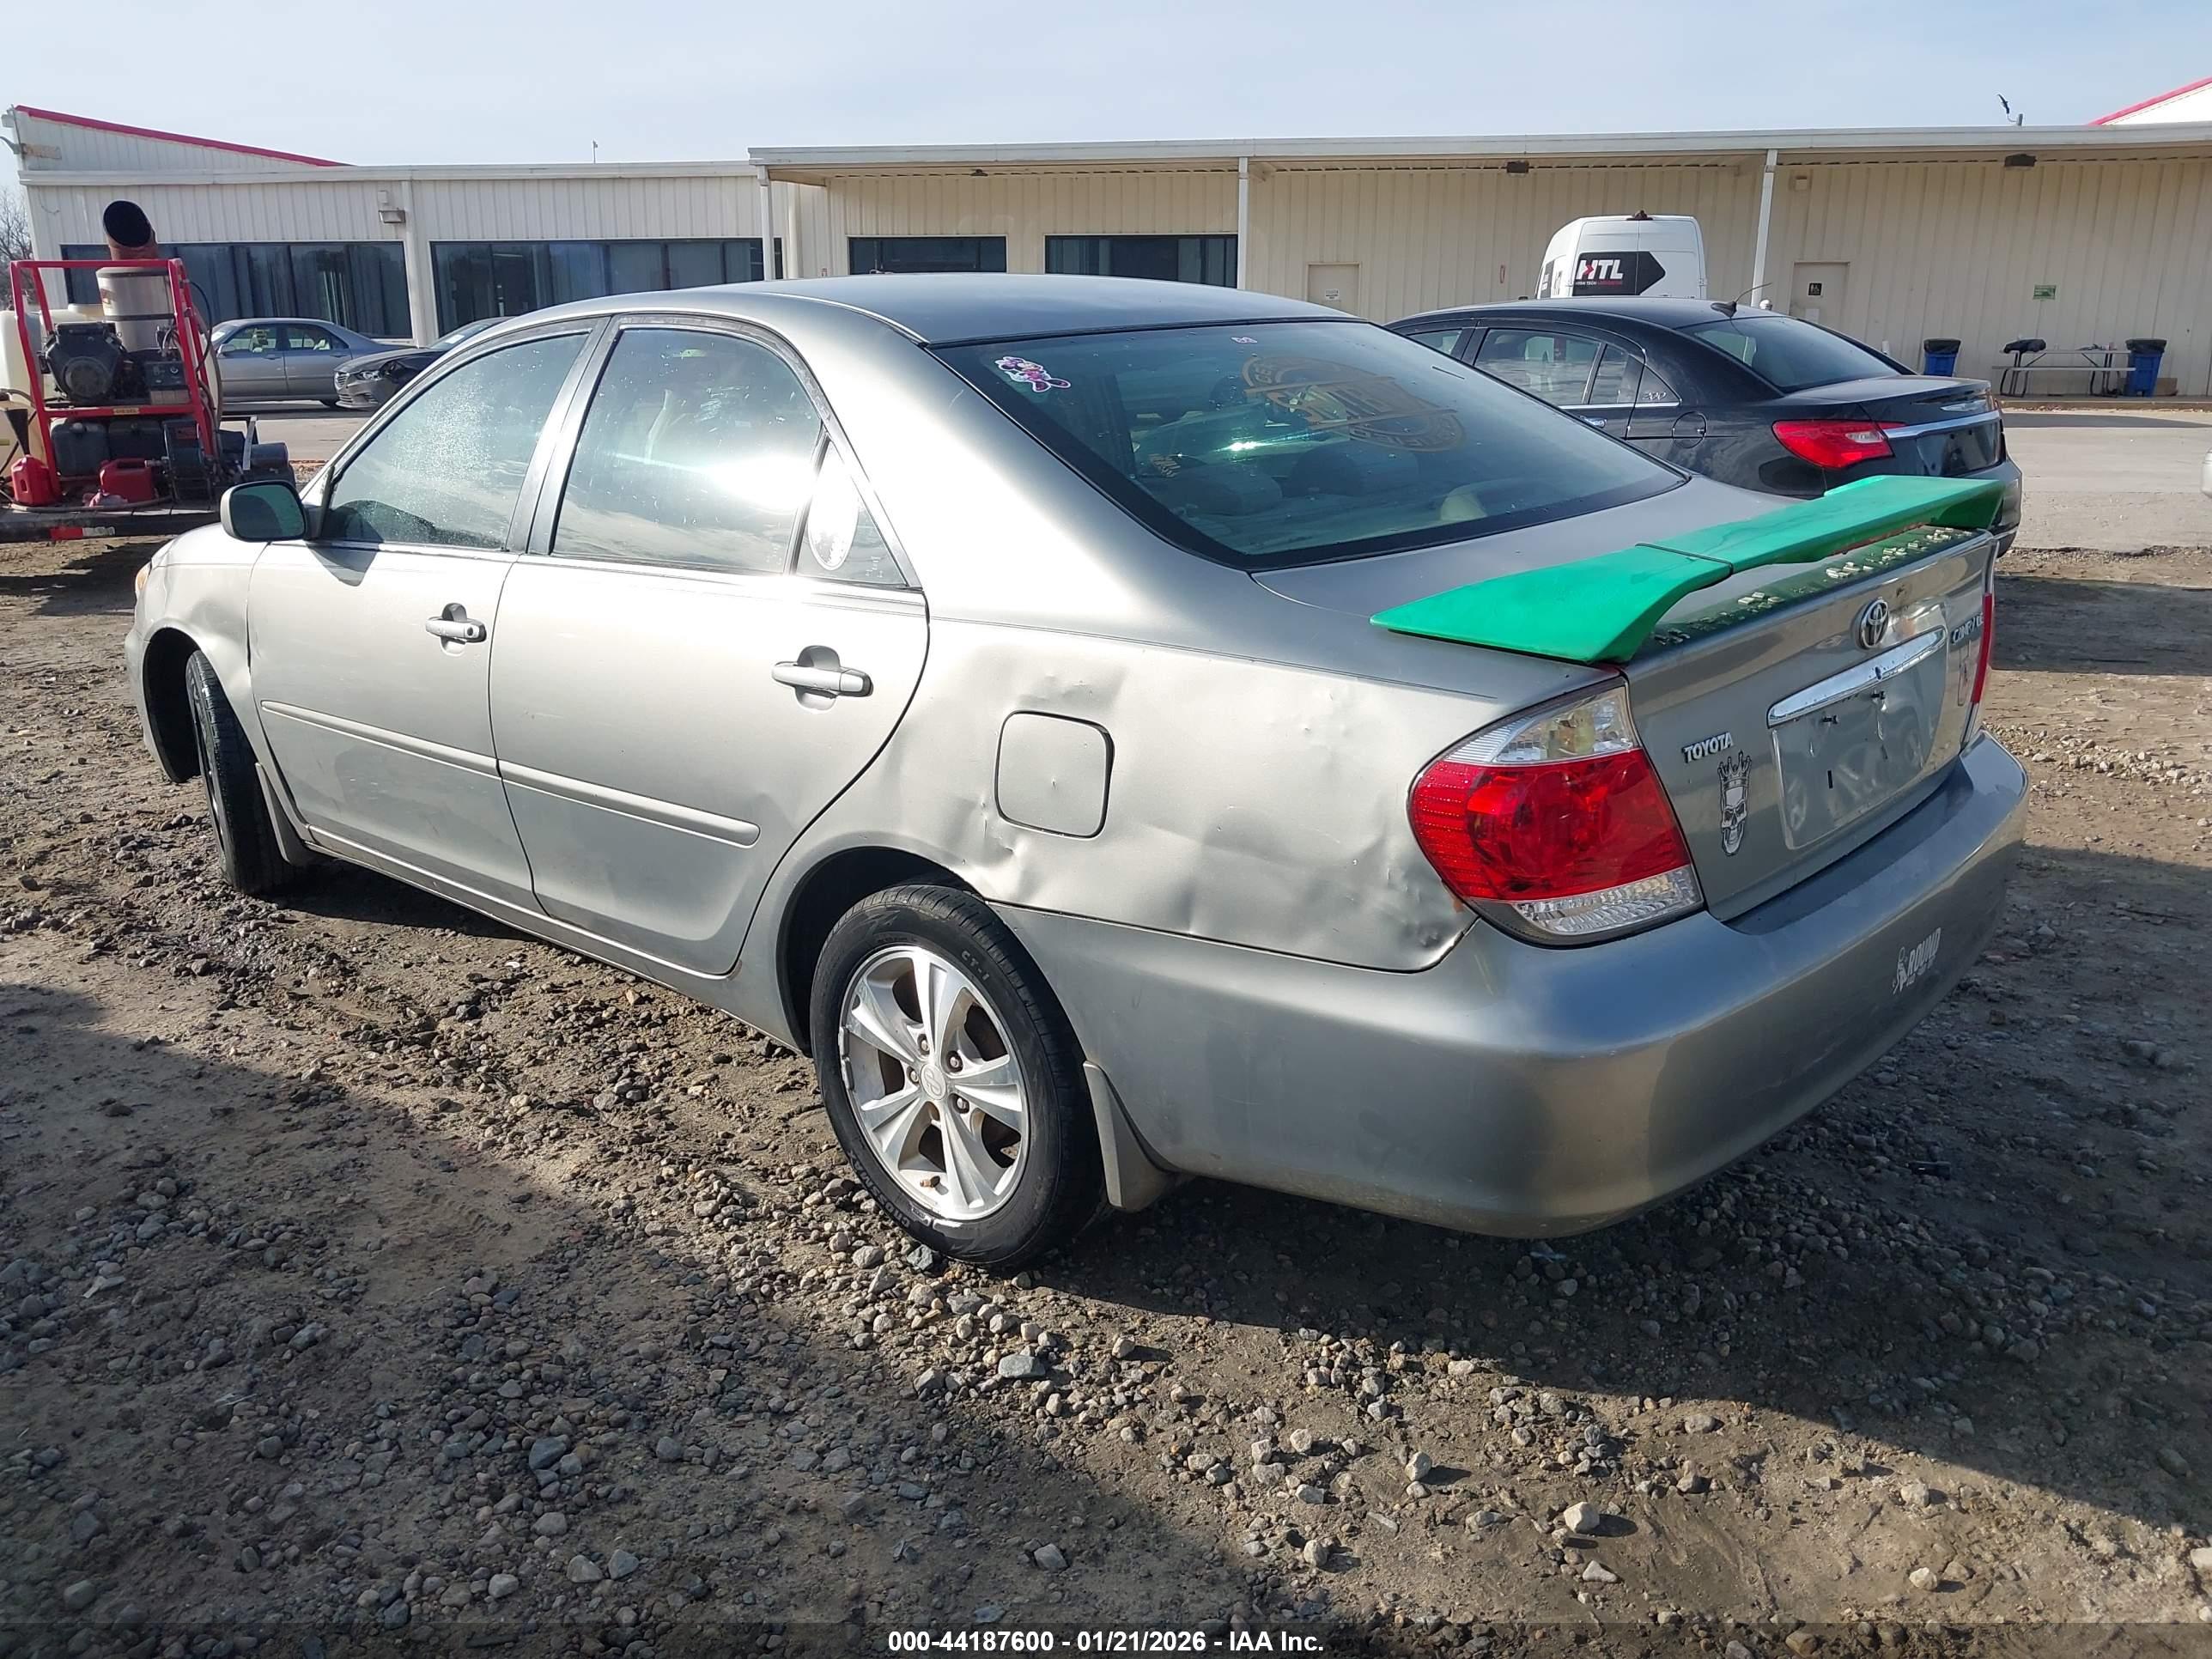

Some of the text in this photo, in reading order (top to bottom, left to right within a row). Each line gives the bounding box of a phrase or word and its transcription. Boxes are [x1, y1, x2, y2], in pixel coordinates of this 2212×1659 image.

[1575, 259, 1624, 280] HTL
[1683, 732, 1735, 763] TOYOTA
[961, 950, 990, 981] CT-1
[848, 1150, 910, 1228] CROSSMAX
